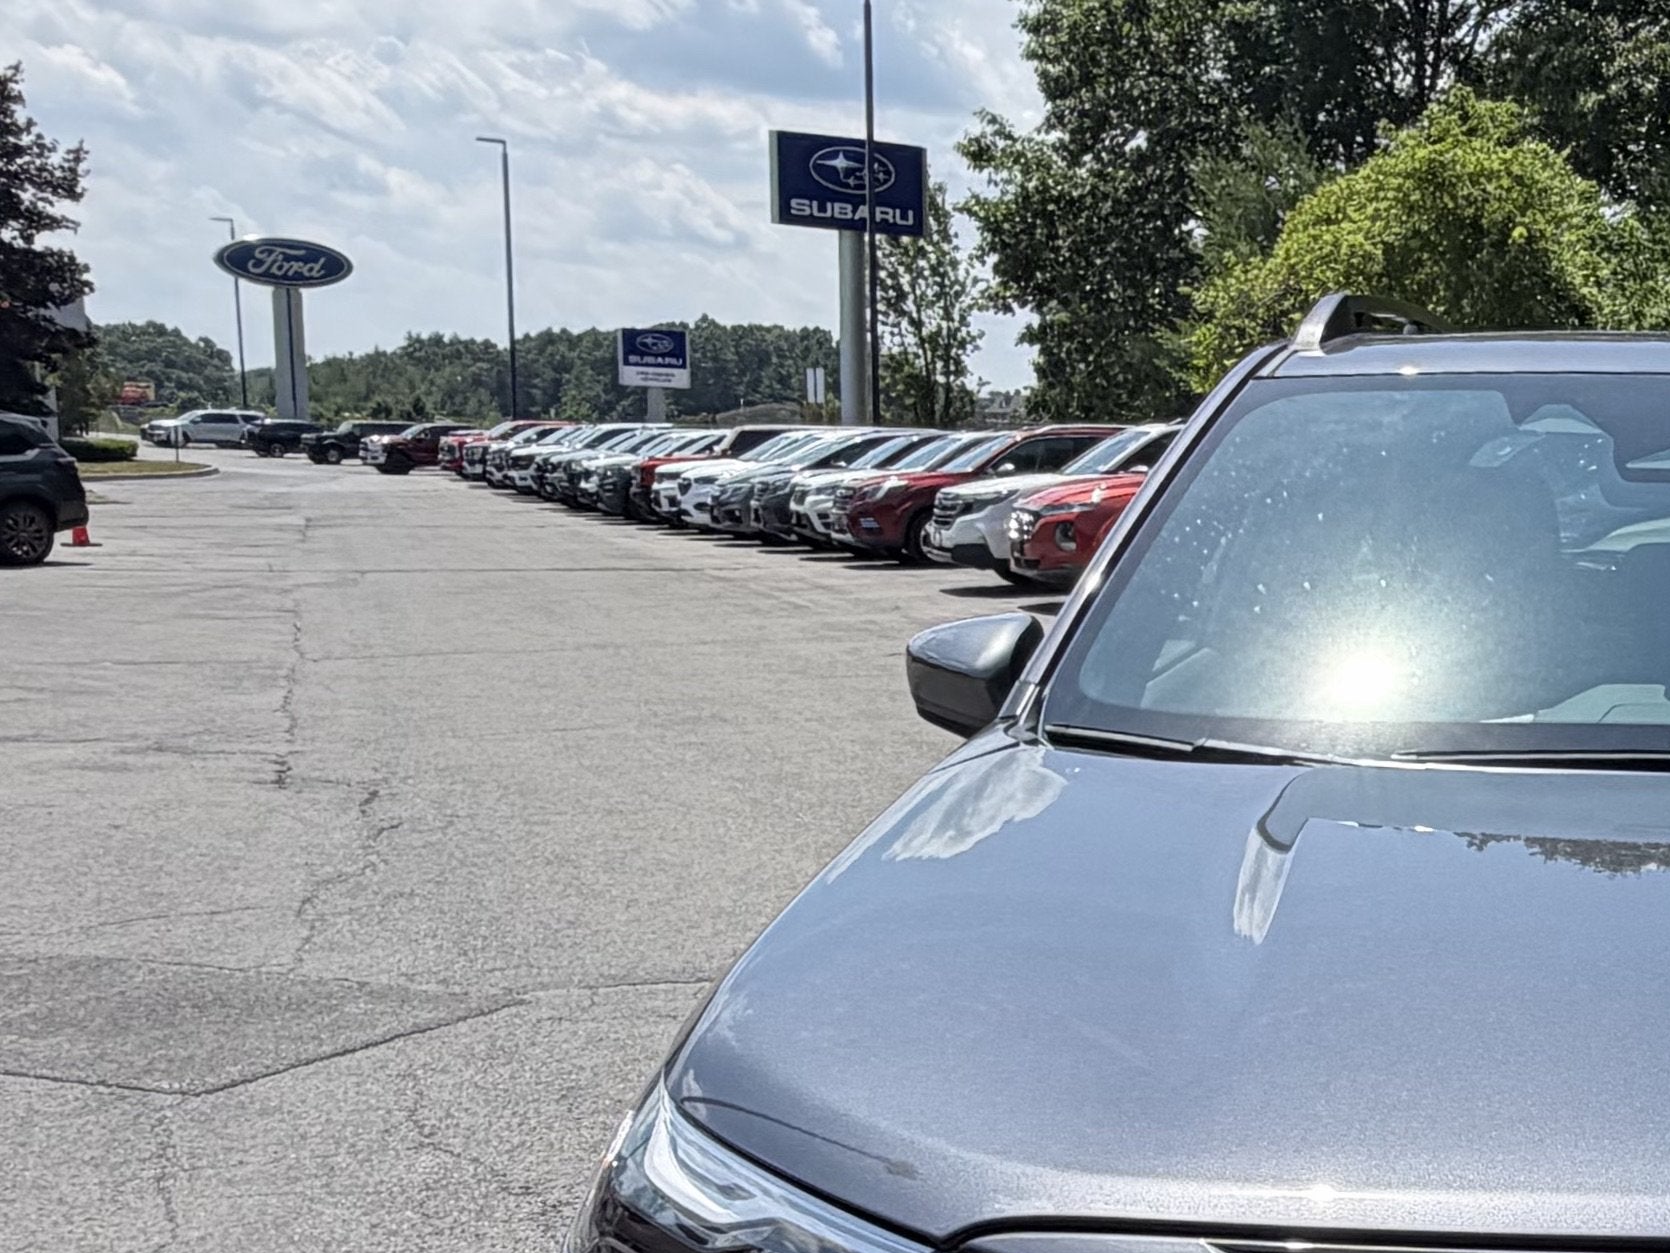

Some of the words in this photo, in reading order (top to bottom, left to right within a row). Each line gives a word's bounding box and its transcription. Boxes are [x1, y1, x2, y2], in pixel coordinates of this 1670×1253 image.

[790, 198, 914, 226] SUBARU
[247, 245, 326, 278] Ford
[628, 355, 683, 366] SUBARU
